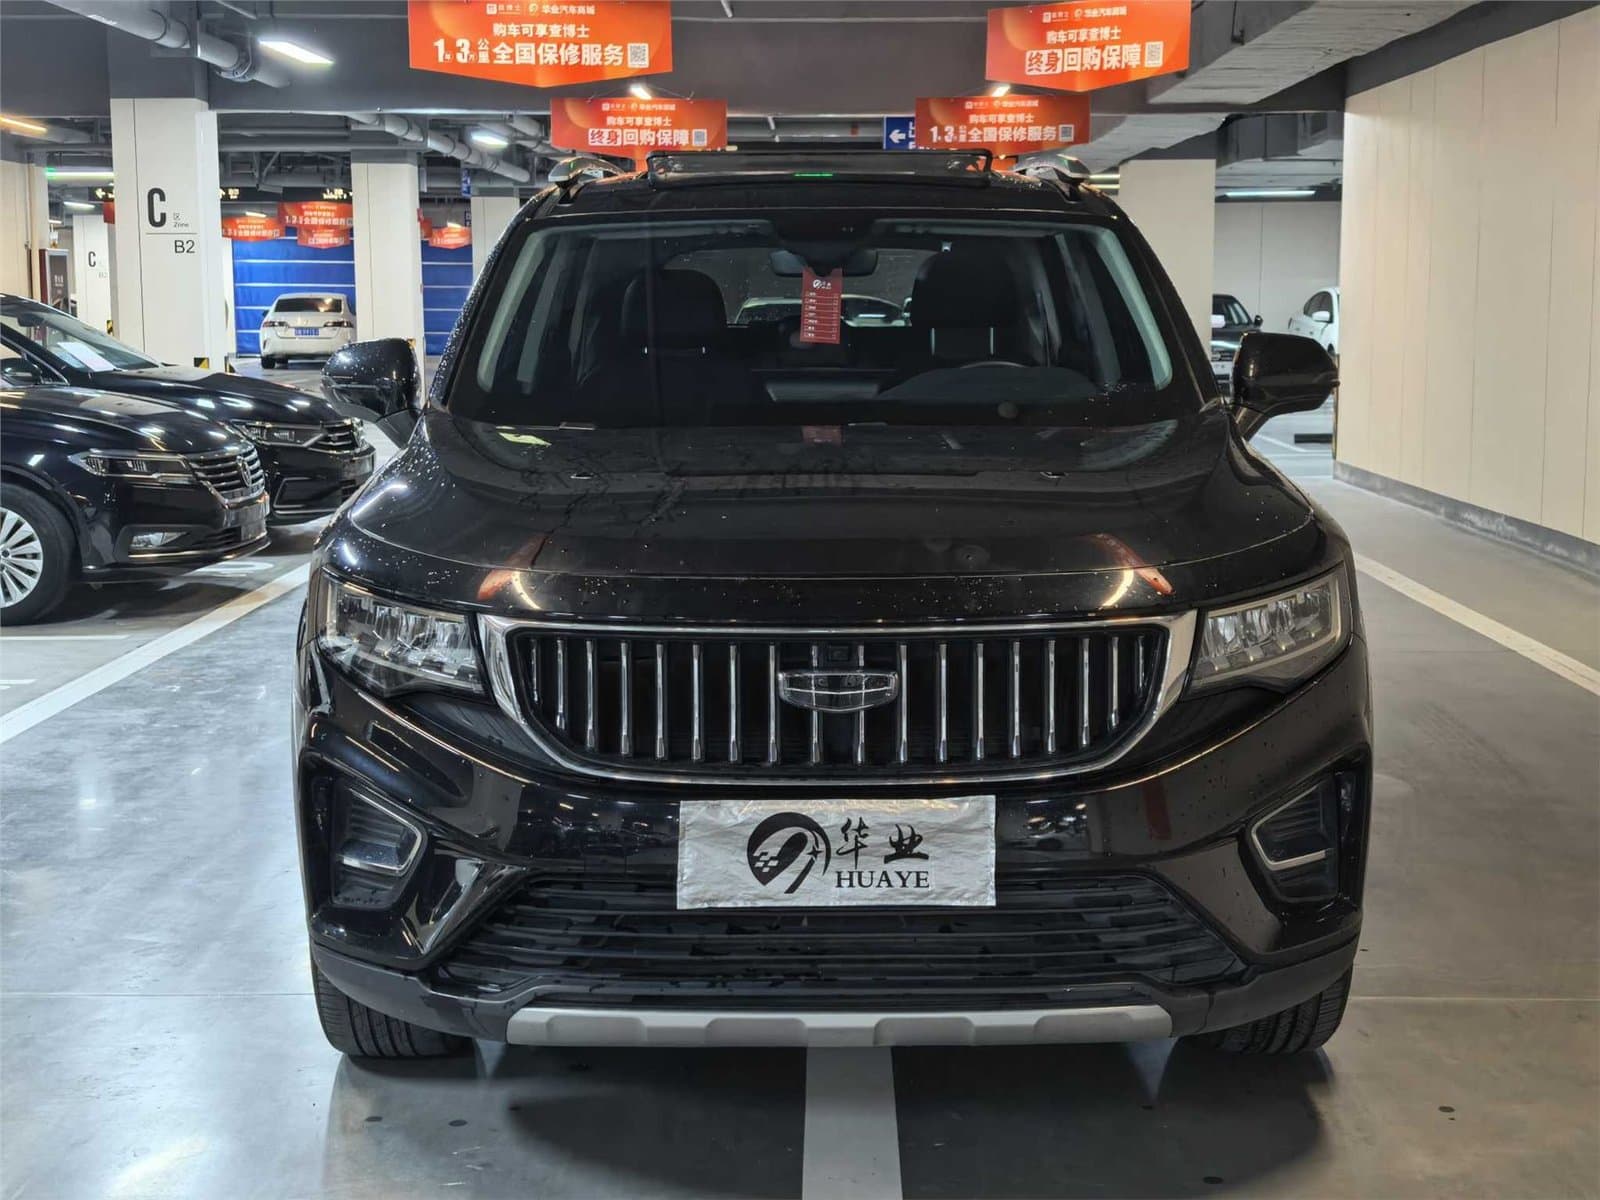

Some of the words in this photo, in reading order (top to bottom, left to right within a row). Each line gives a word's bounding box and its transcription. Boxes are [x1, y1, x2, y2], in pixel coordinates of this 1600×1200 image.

[493, 23, 590, 38] 购车可享查博士
[1046, 26, 1122, 44] 购车可享查博士
[1026, 43, 1141, 74] 终身回购保障
[588, 128, 689, 147] 终身回购保障
[147, 187, 167, 228] C
[174, 239, 196, 254] B2
[88, 251, 97, 267] C
[835, 816, 930, 869] 华业
[835, 871, 930, 888] HUAYE
